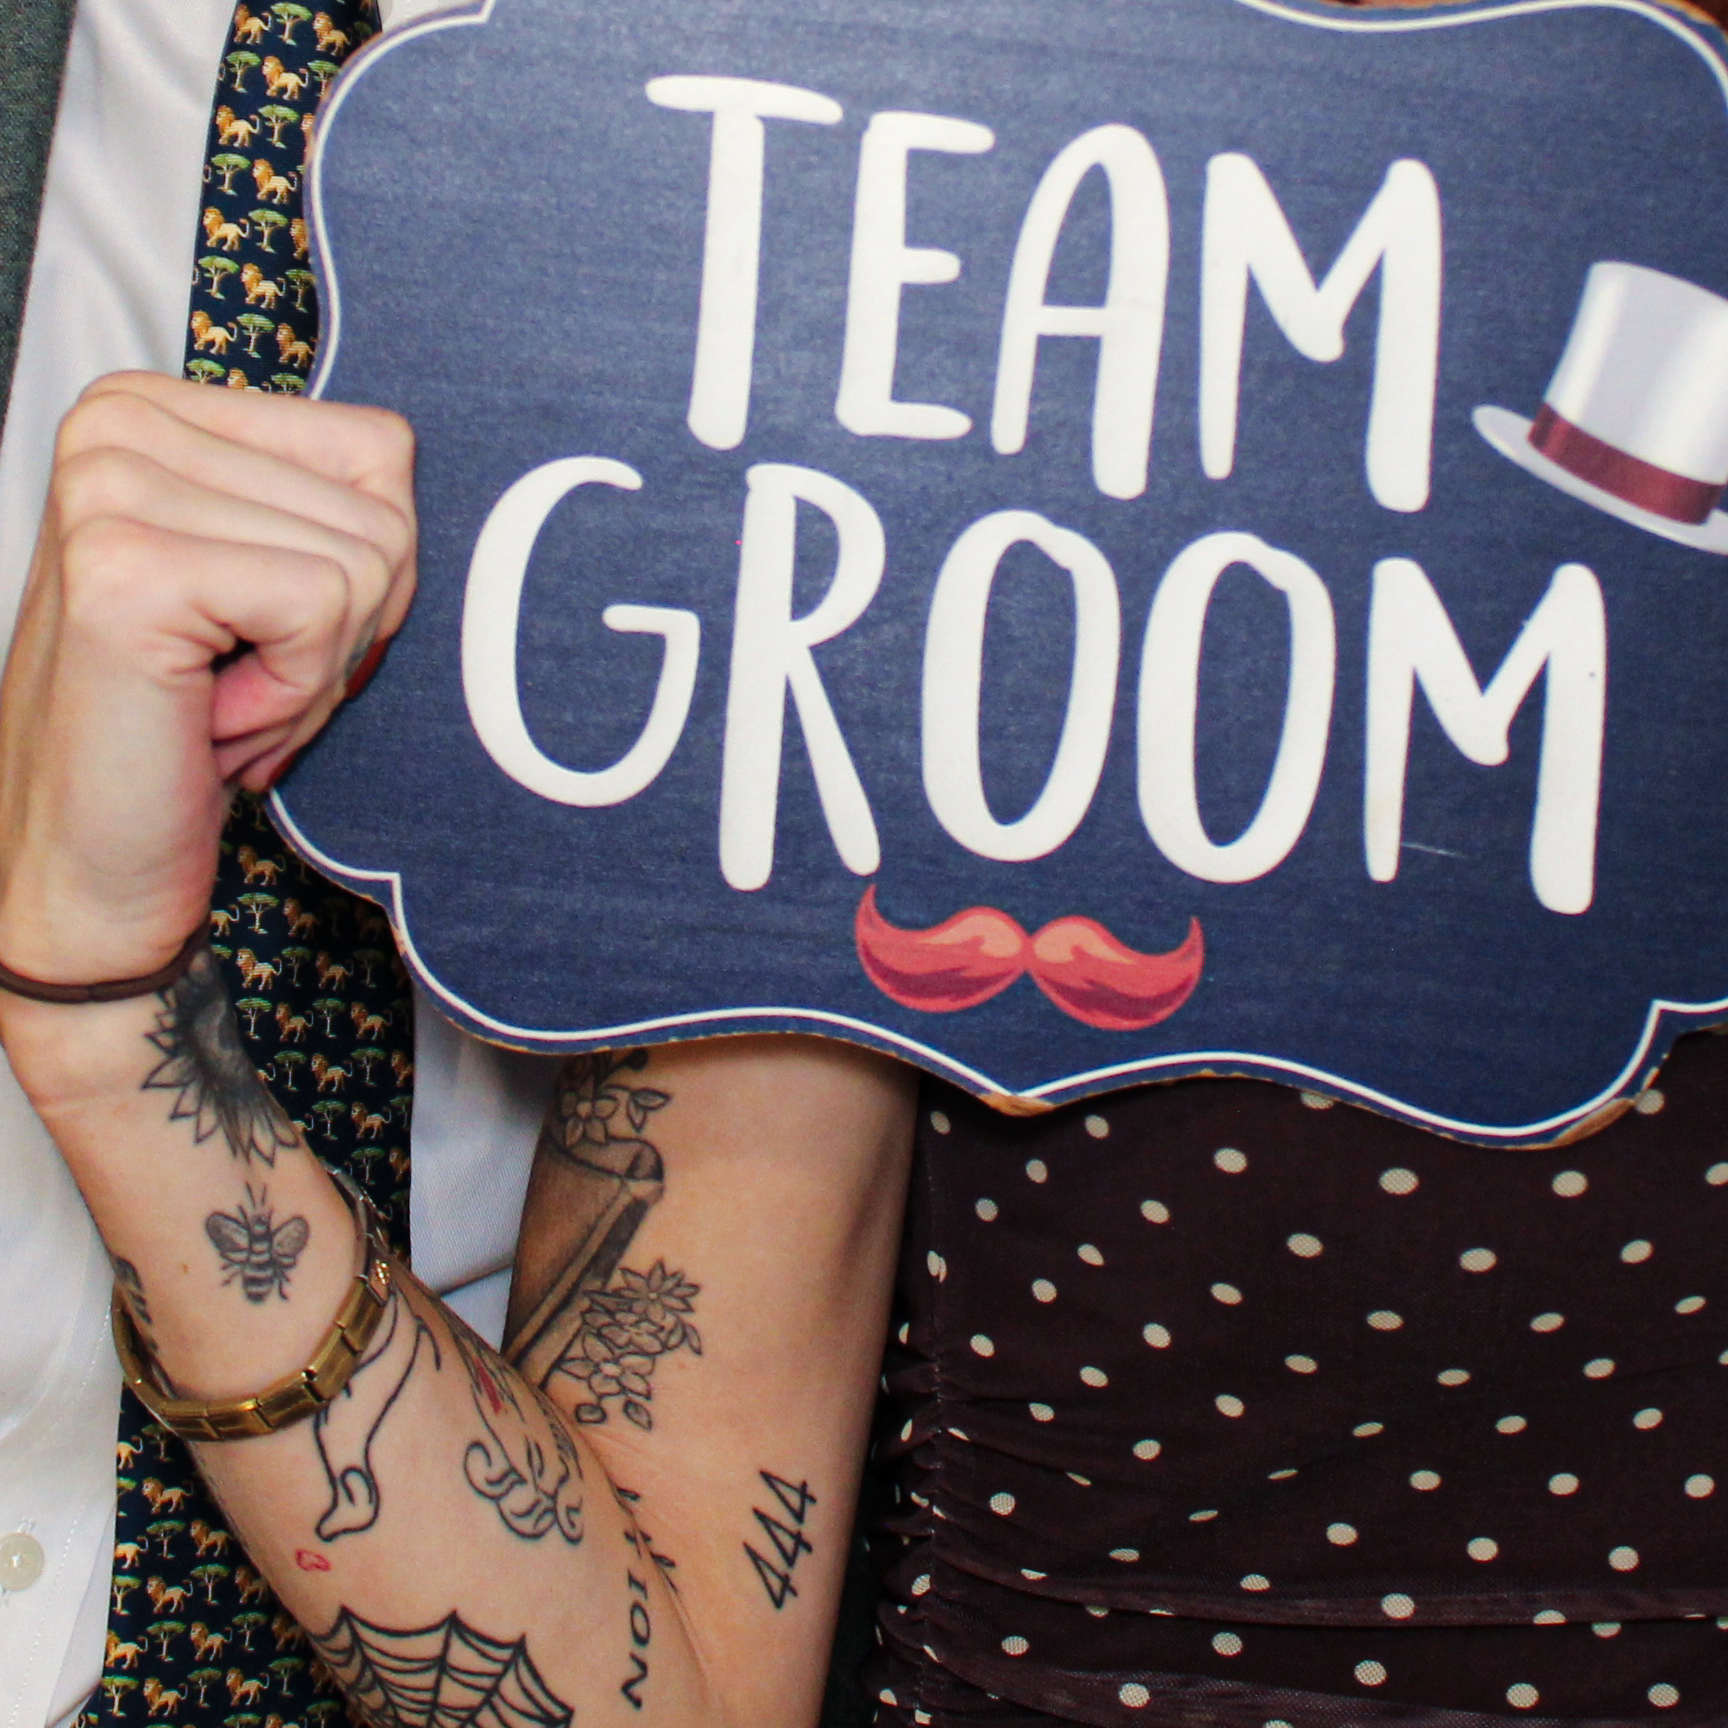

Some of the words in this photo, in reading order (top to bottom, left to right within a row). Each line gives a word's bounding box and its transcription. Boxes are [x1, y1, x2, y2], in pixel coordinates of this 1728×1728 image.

[645, 74, 1443, 513] TEAM
[460, 454, 1607, 916] GROOM
[742, 1469, 817, 1610] 444
